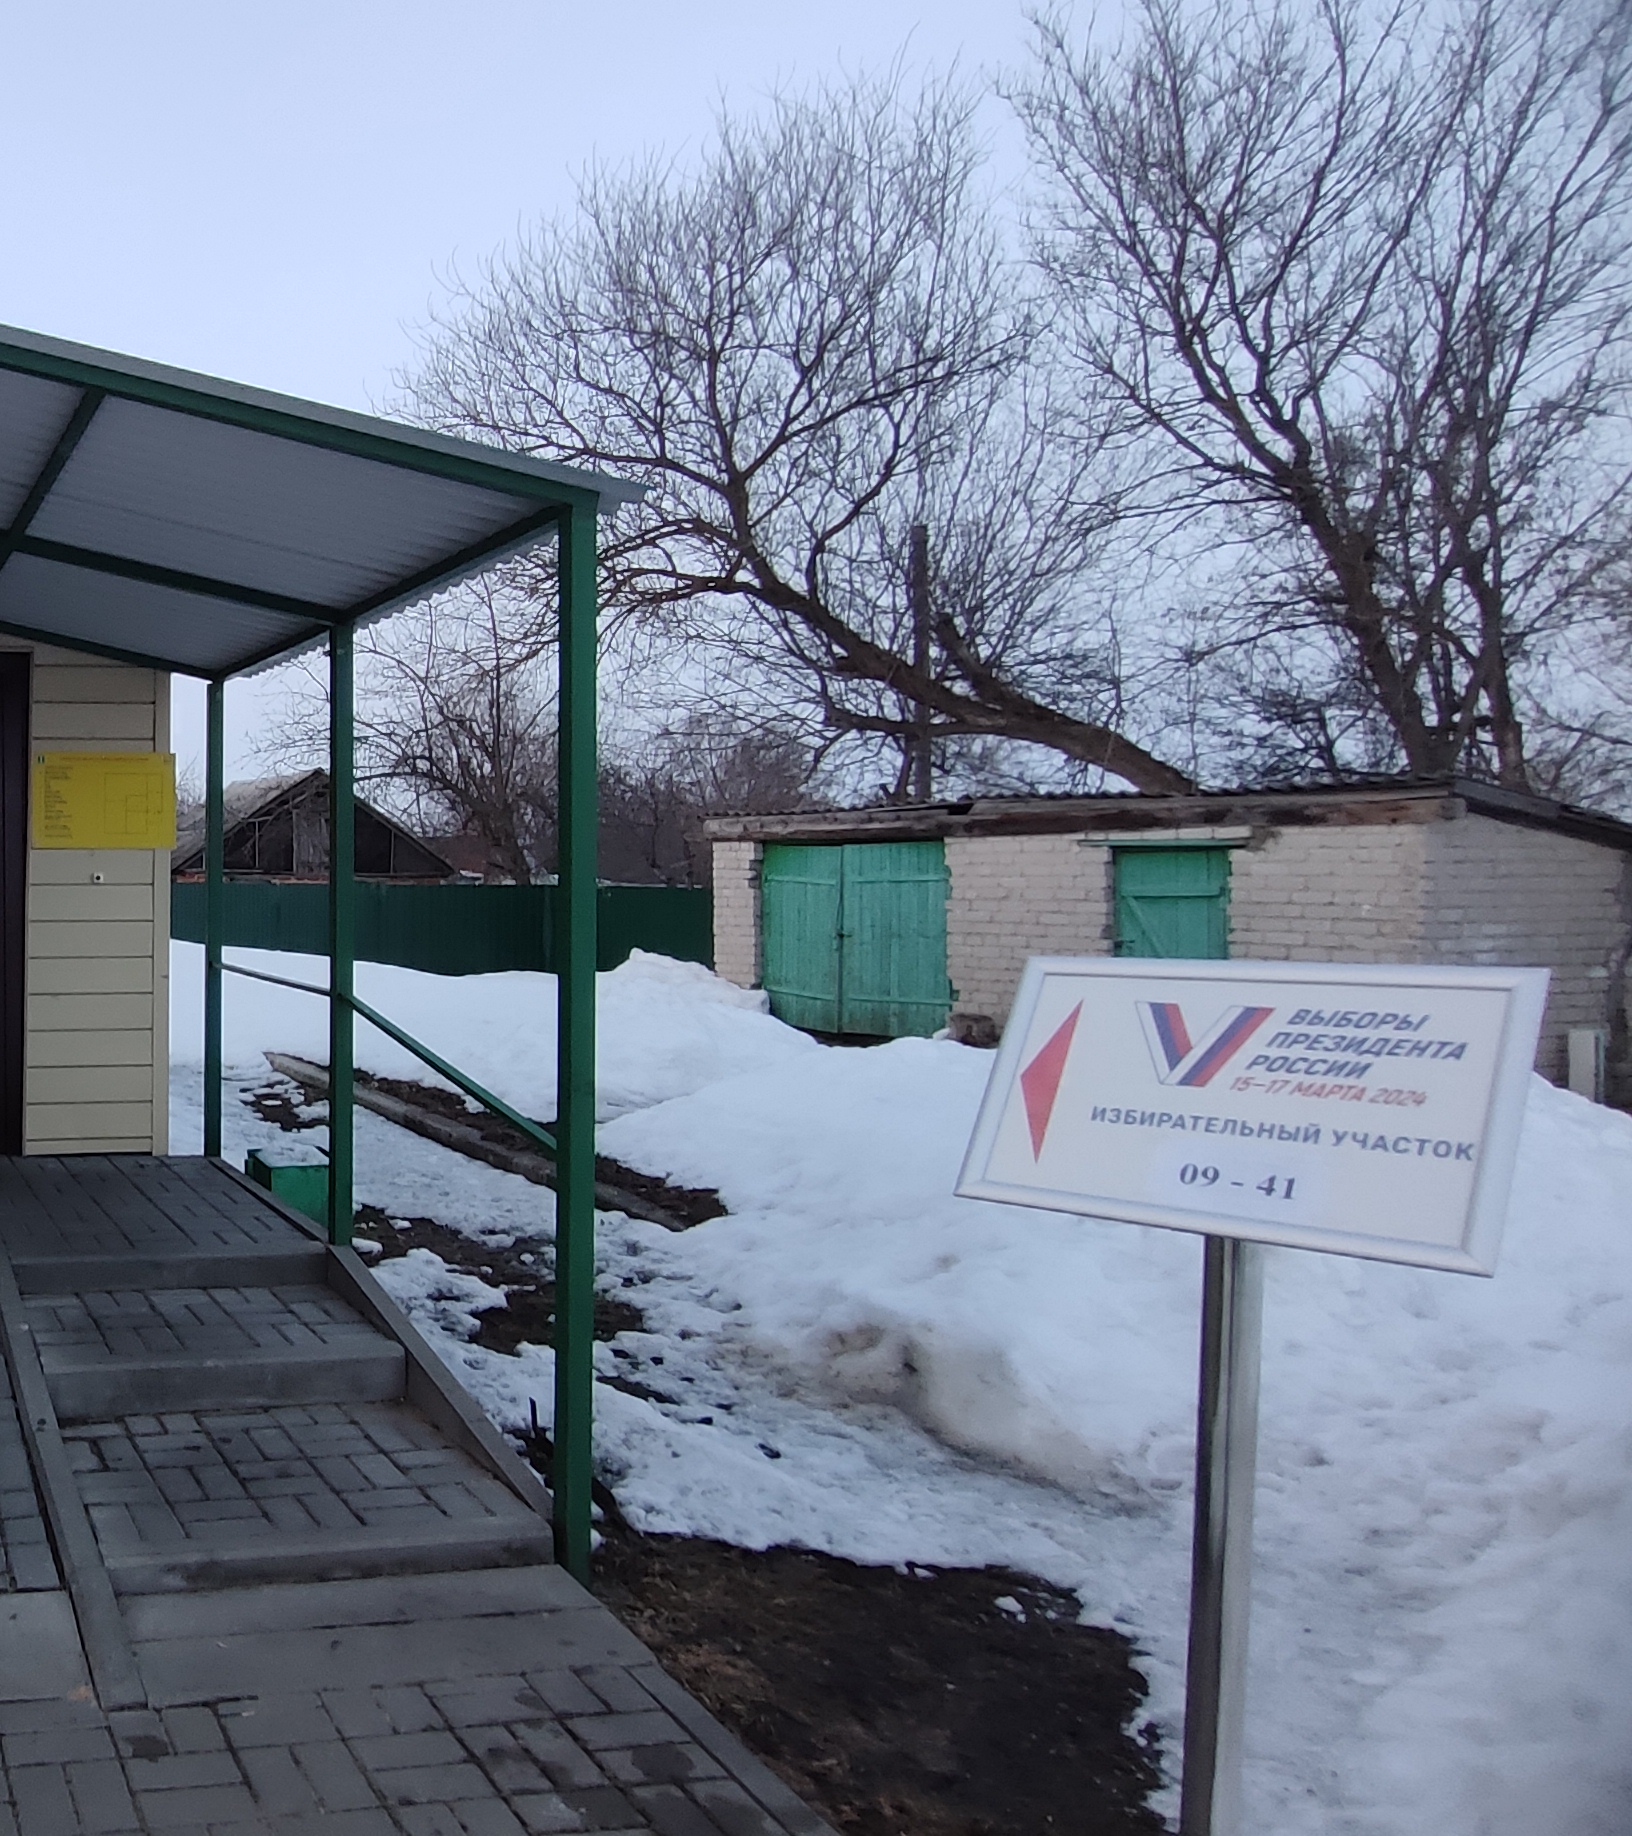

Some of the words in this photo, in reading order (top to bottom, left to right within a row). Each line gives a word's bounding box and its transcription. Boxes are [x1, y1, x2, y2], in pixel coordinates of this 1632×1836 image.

[1286, 1008, 1431, 1033] ВЫБОРЫ
[1265, 1031, 1468, 1061] ПРЕЗИДЕНТА
[1245, 1054, 1374, 1080] РОССИИ
[1289, 1080, 1367, 1103] МАРТА
[1368, 1087, 1429, 1108] 2024
[1090, 1105, 1321, 1145] ИЗБИРАТЕЛЬНЫЙ
[1331, 1129, 1475, 1163] УЧАСТОК
[1179, 1162, 1220, 1187] 09
[1256, 1174, 1296, 1200] 41
